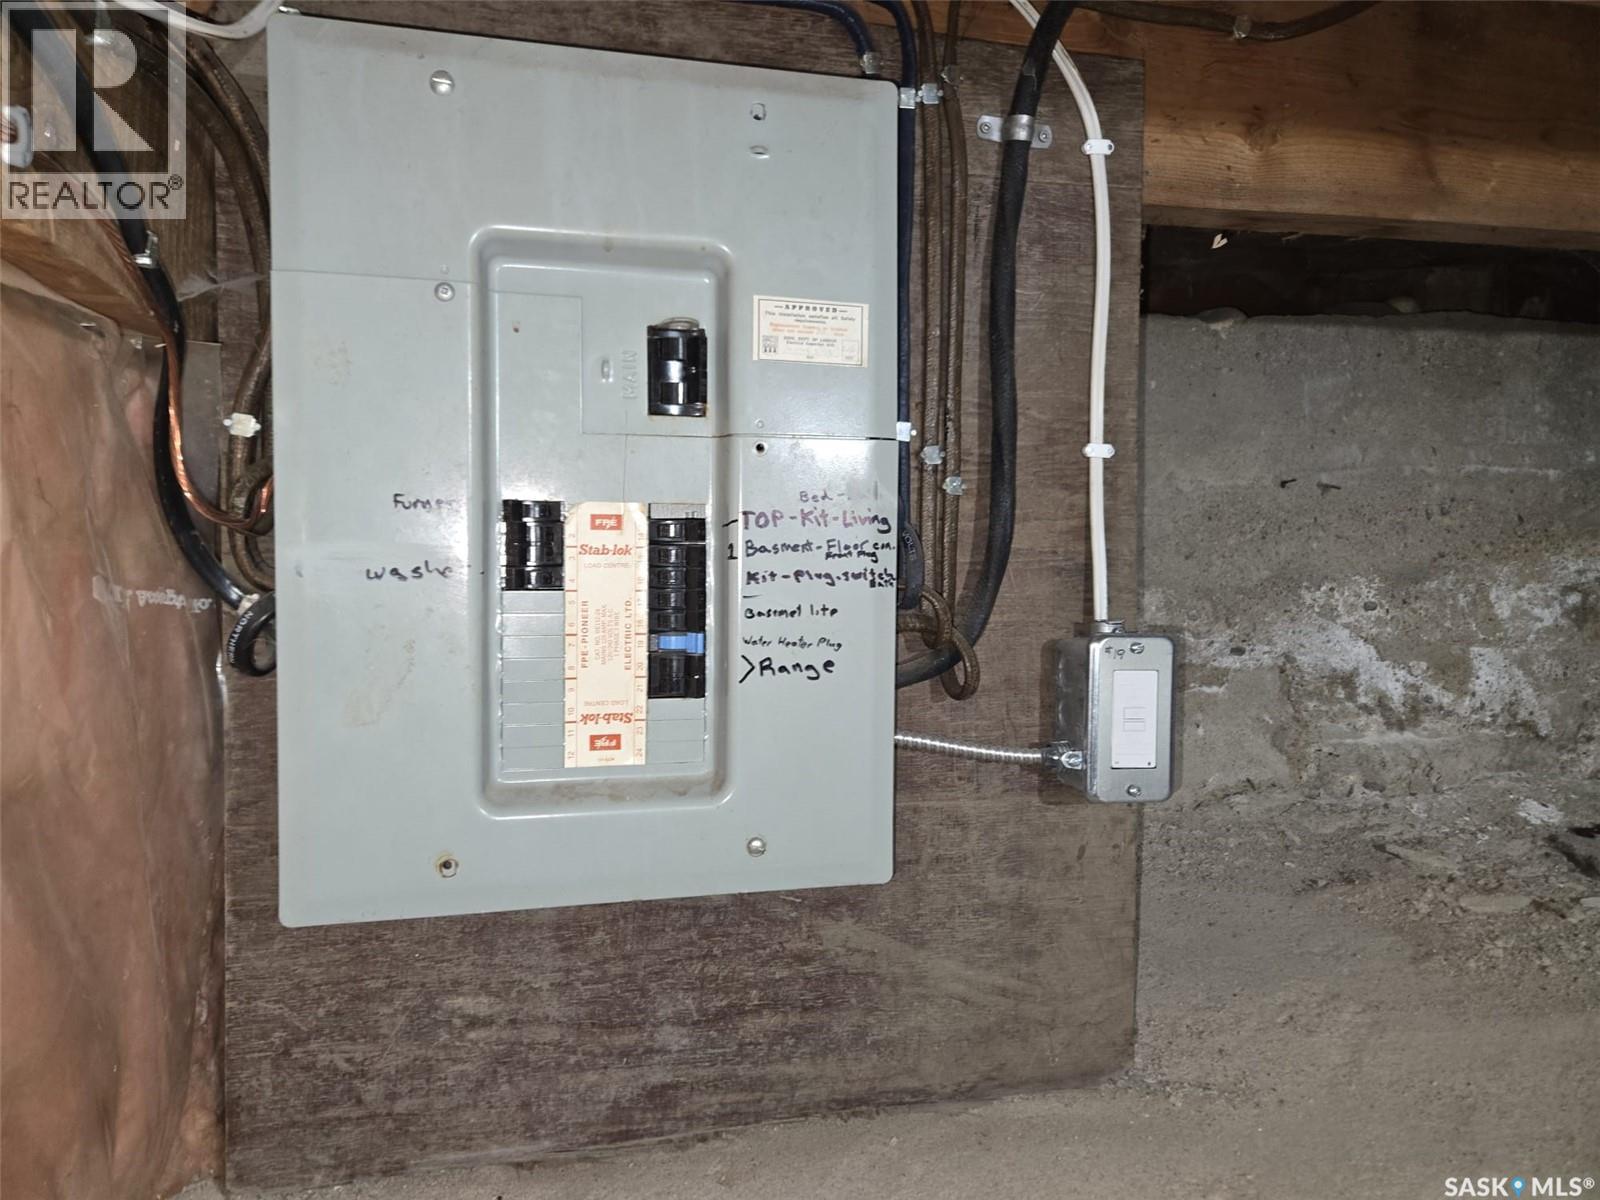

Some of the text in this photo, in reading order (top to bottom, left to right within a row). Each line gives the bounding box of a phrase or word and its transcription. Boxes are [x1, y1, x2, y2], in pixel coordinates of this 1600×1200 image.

[784, 304, 838, 313] APPROVED
[579, 544, 632, 557] Stab-lok
[759, 656, 836, 681] Range
